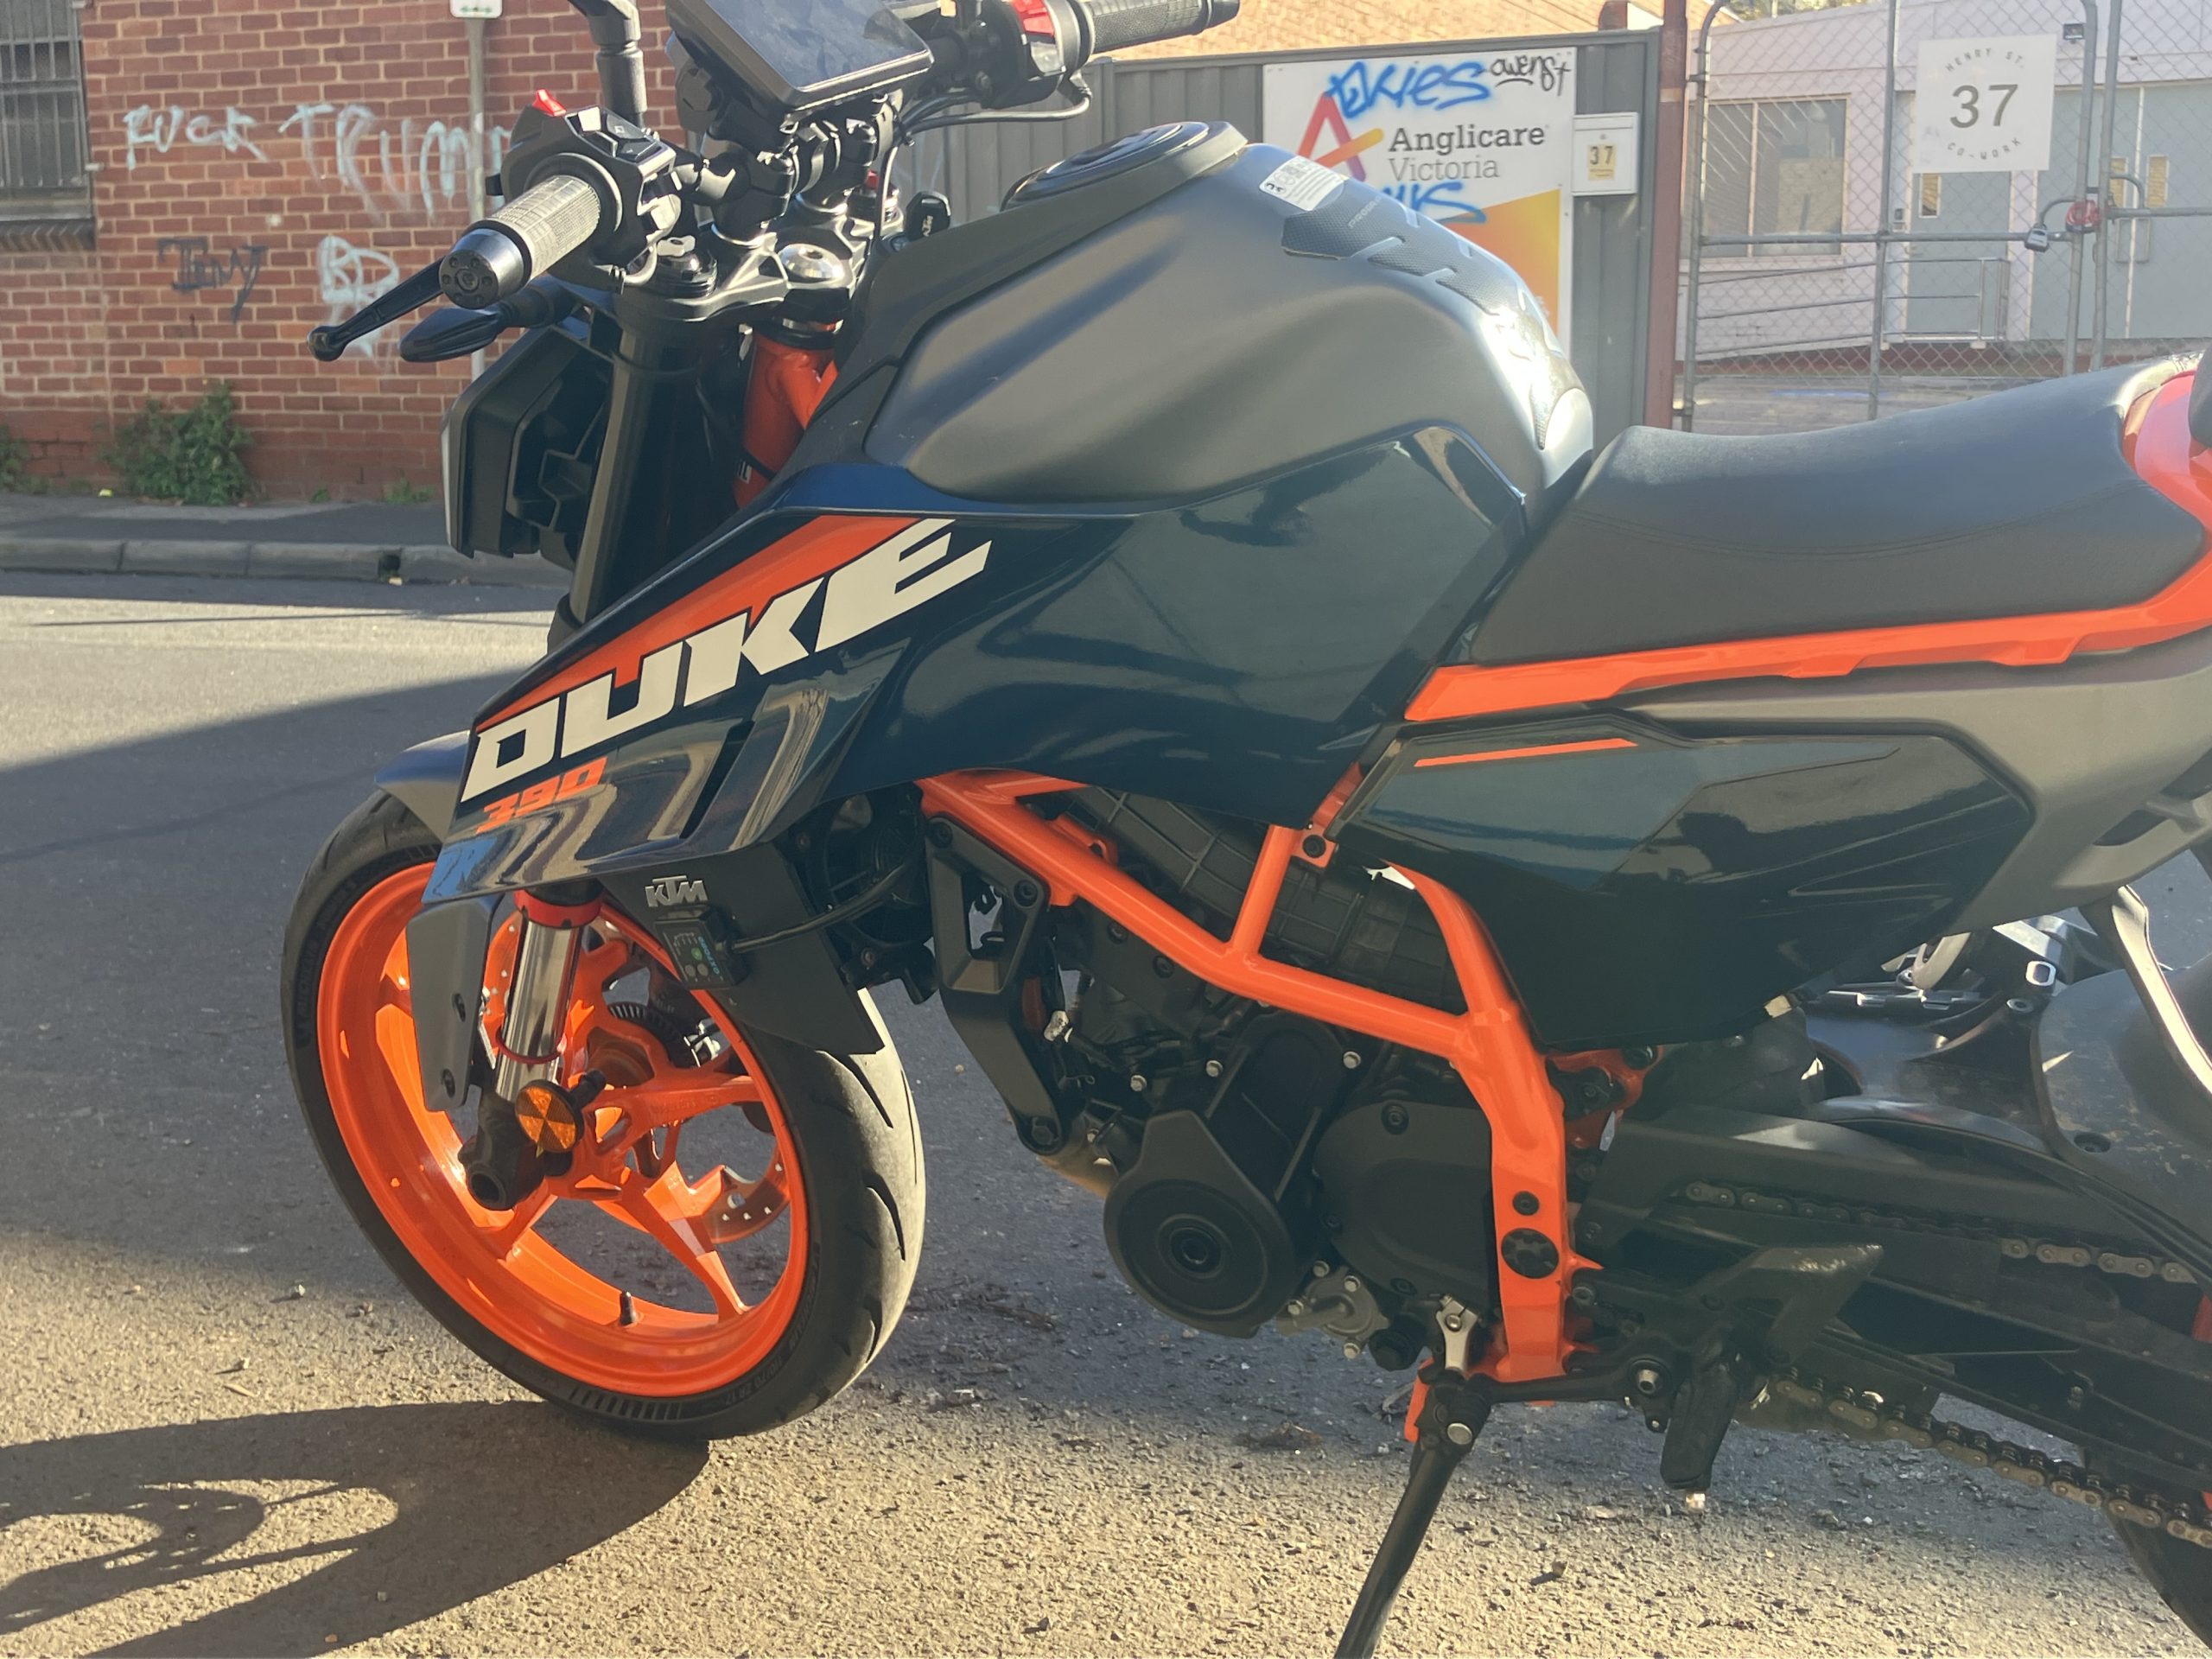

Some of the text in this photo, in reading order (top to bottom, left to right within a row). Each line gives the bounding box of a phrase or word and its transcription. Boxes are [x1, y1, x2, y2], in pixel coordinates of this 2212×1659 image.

[1945, 48, 1992, 72] HENRY
[1949, 84, 2018, 129] 37
[123, 104, 270, 172] FUCK
[1388, 123, 1545, 156] Anglicare
[1947, 137, 2021, 161] CO-WORK
[1387, 153, 1501, 182] Victoria
[1589, 145, 1613, 166] 37
[461, 518, 993, 803] DUKE
[476, 755, 608, 835] 390
[645, 874, 709, 908] KTM
